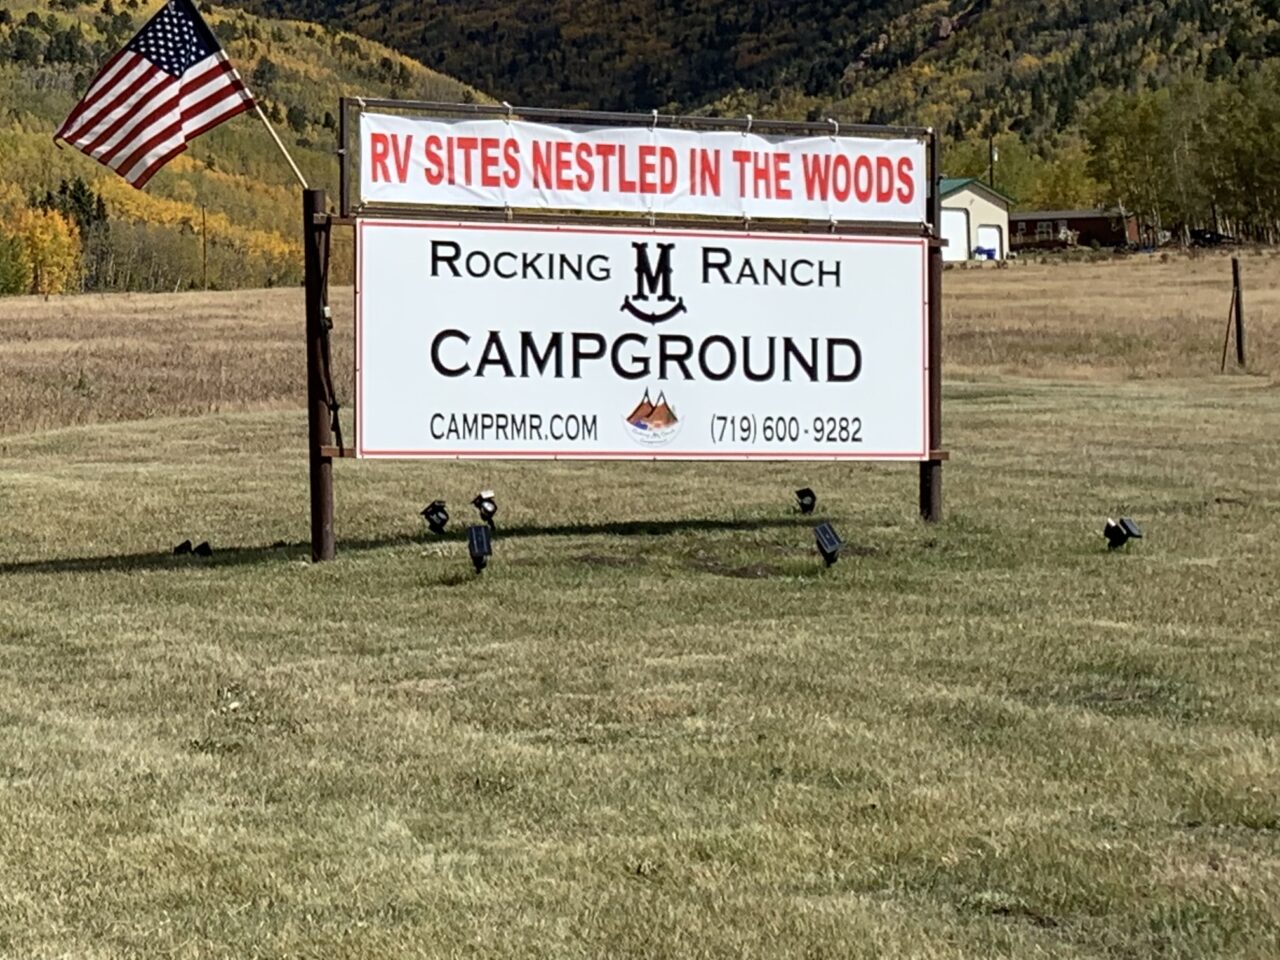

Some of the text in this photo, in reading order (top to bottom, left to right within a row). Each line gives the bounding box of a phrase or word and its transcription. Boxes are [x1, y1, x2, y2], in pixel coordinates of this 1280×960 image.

[370, 132, 914, 204] RV SITES NESTLED IN THE WOODS
[631, 242, 676, 302] M
[430, 329, 863, 383] CAMPGROUND
[430, 413, 598, 441] CAMPRMR.COM
[711, 414, 757, 442] (719)
